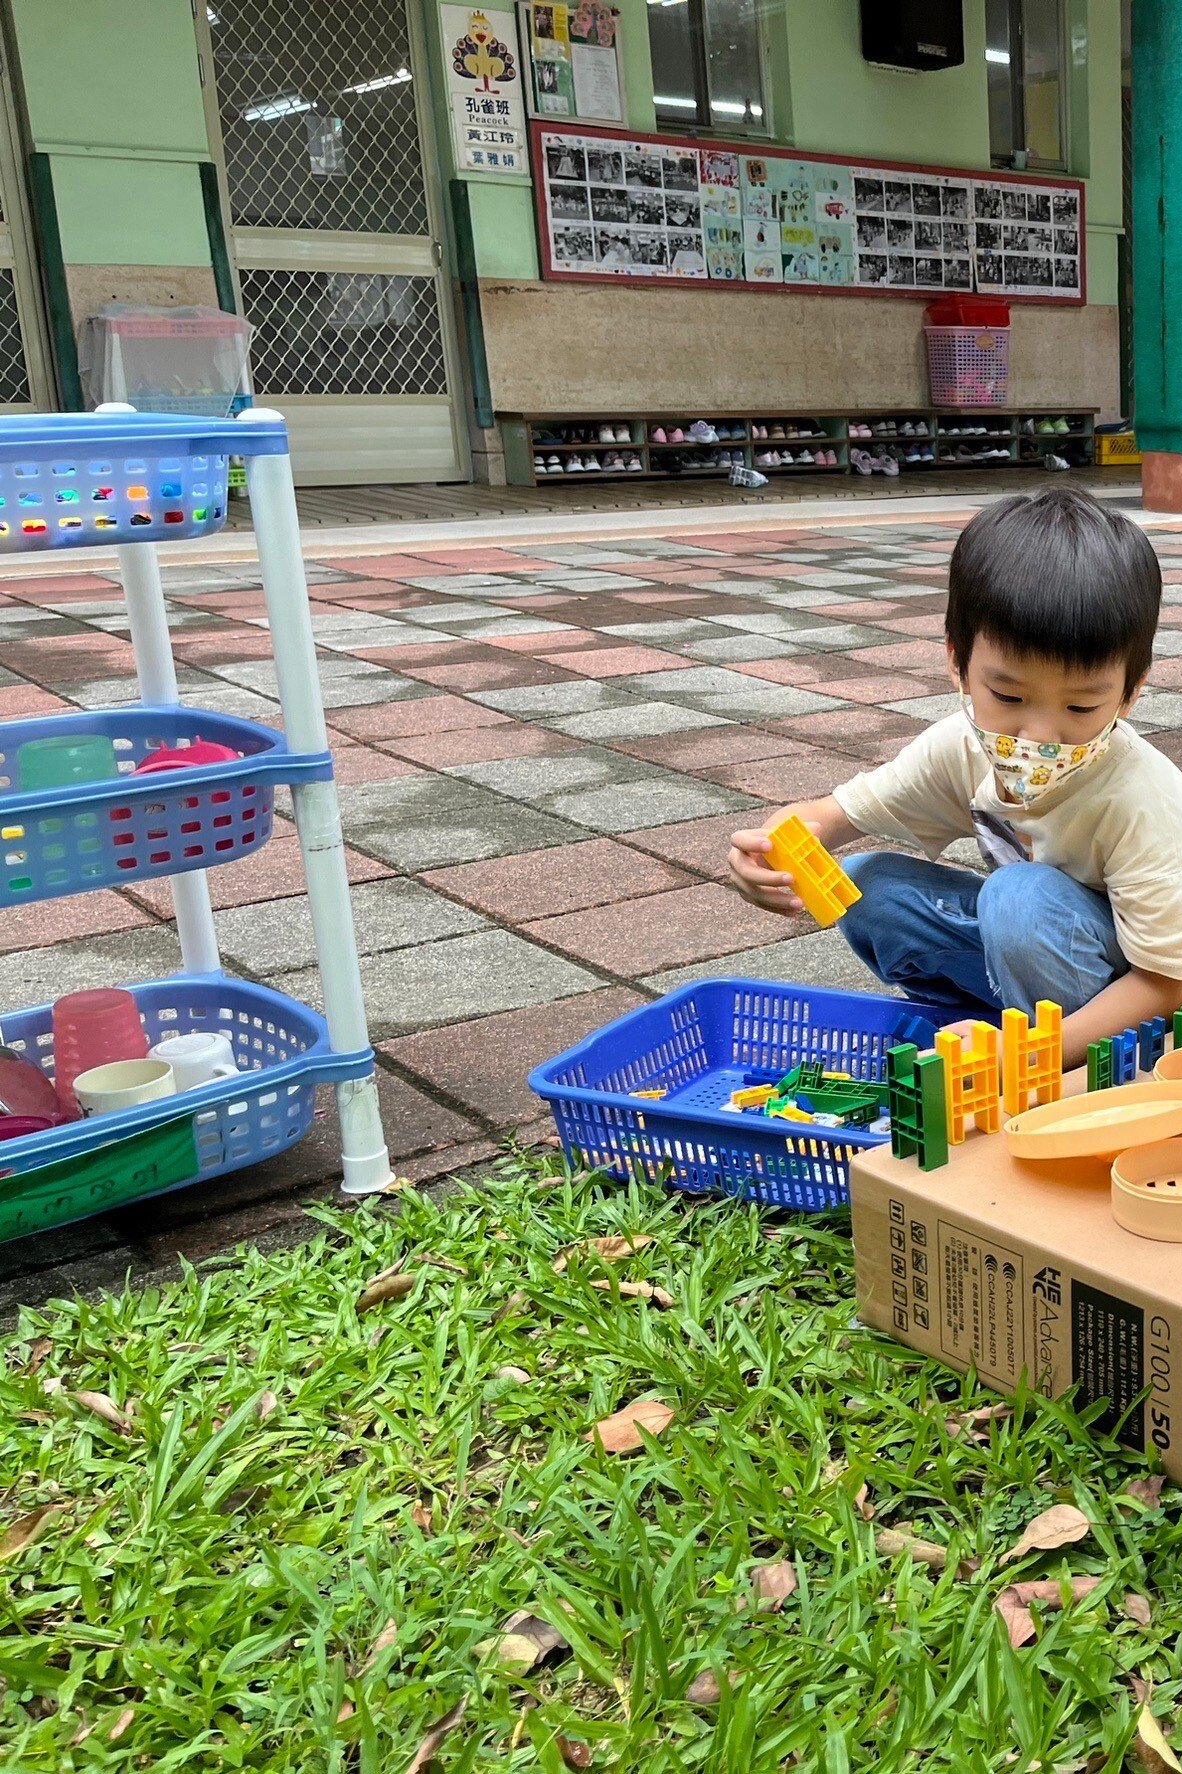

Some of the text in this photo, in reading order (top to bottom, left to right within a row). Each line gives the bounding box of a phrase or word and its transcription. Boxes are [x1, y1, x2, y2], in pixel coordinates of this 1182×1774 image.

[465, 97, 511, 115] 孔雀班
[469, 114, 509, 125] Peacock
[467, 128, 514, 143] 黃江玲
[1150, 1316, 1170, 1393] G100
